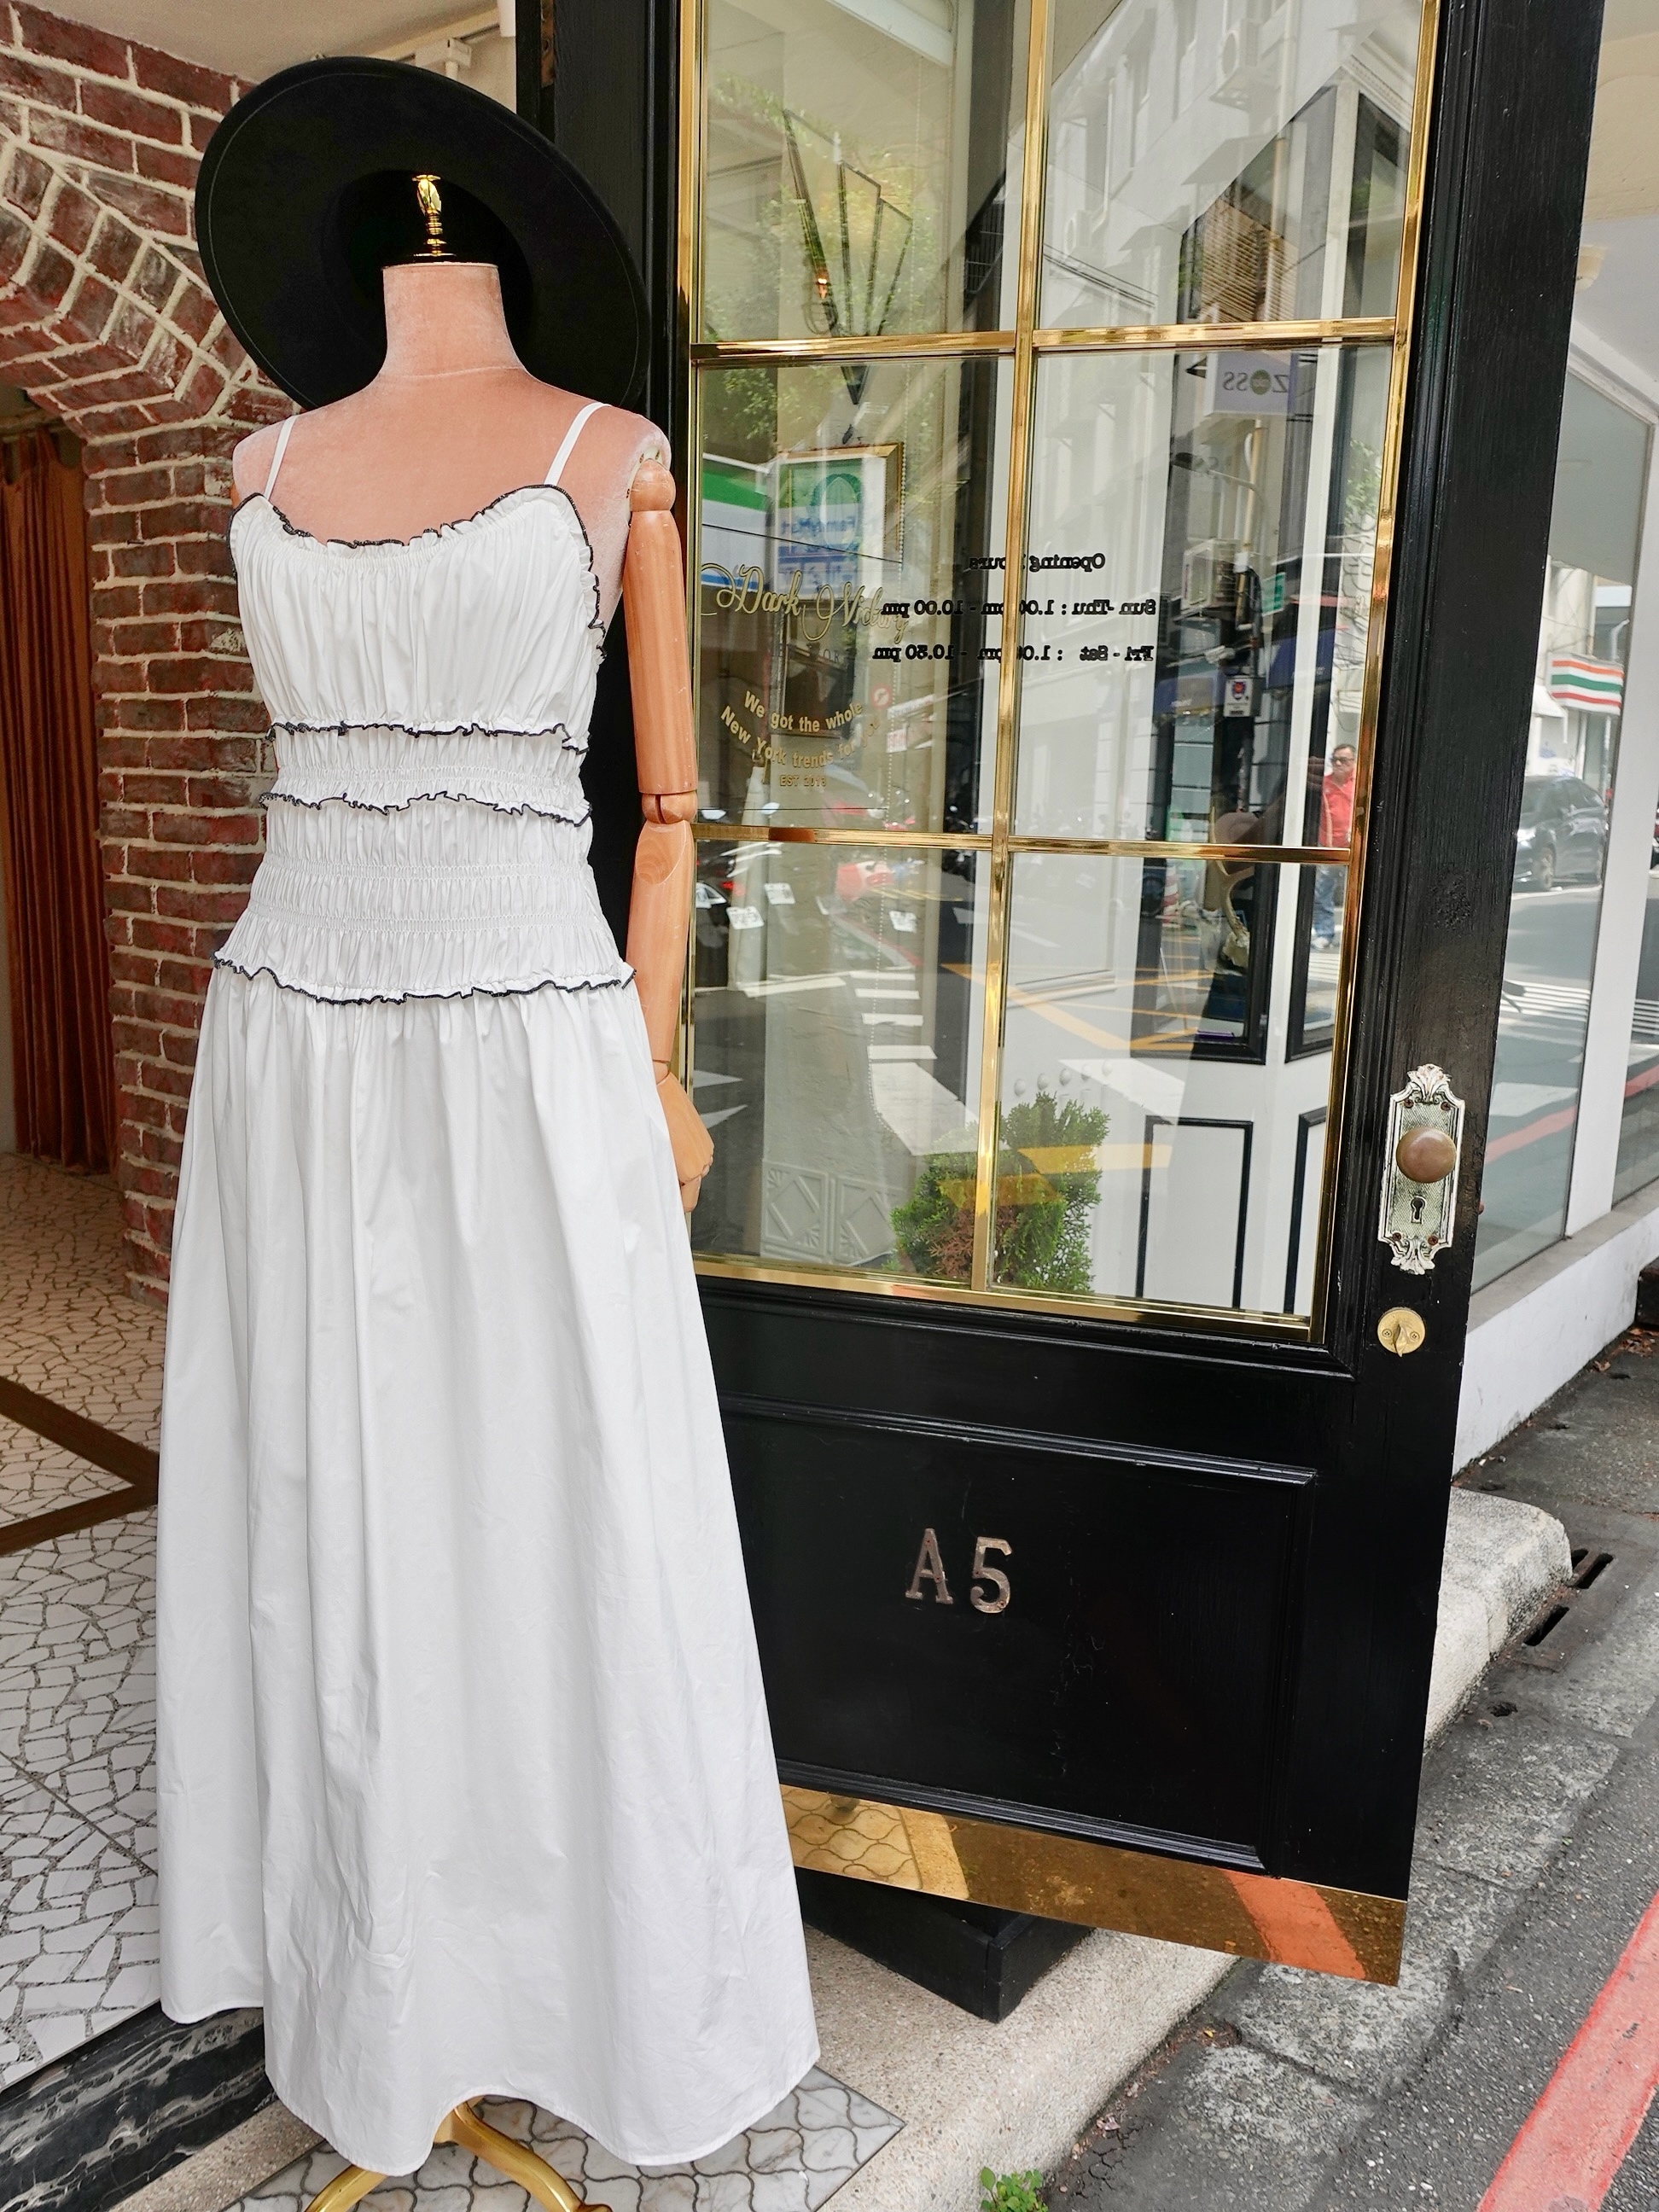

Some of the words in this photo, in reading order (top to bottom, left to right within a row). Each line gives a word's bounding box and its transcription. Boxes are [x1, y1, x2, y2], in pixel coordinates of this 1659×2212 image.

[701, 562, 802, 615] Dark
[801, 581, 910, 644] Victory
[720, 705, 752, 744] New
[756, 736, 787, 765] York
[791, 751, 835, 770] trends
[838, 742, 856, 760] for
[744, 690, 765, 719] We
[771, 712, 794, 731] got
[799, 716, 820, 733] the
[825, 701, 864, 730] whole
[779, 775, 800, 787] EST
